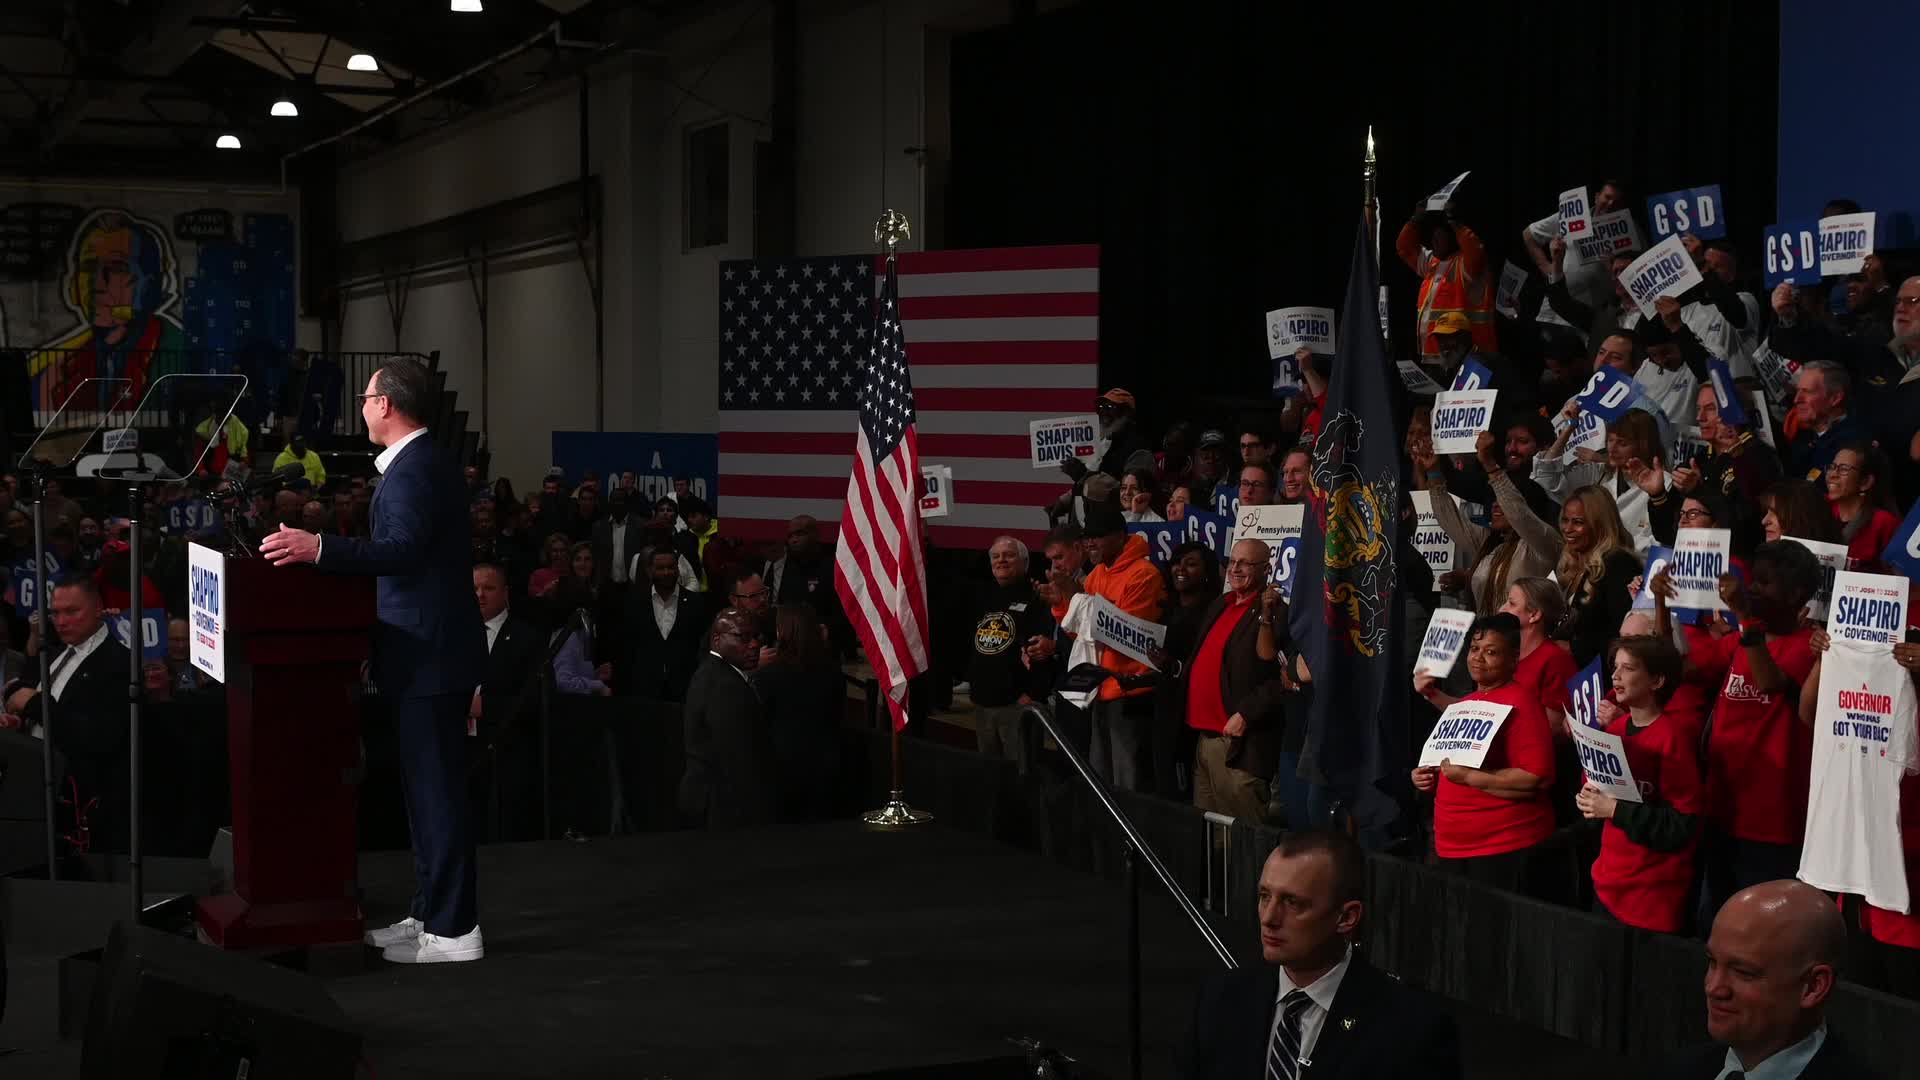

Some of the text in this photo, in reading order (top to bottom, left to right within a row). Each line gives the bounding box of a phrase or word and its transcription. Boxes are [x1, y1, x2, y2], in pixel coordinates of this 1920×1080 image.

[1560, 199, 1584, 219] PIRO
[1820, 230, 1866, 253] HAPIRO
[1821, 251, 1857, 262] OVERNOR
[1630, 252, 1684, 300] SHAPIRO
[1645, 274, 1680, 303] GOVERNOR
[1271, 319, 1329, 340] SAPIRO
[1281, 336, 1320, 346] GOERNOR
[1578, 371, 1631, 409] SD
[1434, 407, 1486, 430] SHAPIRO
[1036, 426, 1094, 446] SHAPIRO
[1440, 429, 1473, 439] GOVERNOR
[650, 450, 663, 469] A
[1038, 445, 1073, 462] DAVIS
[1256, 525, 1301, 535] Pennsylvania
[1423, 551, 1448, 564] PIRO
[1671, 551, 1723, 578] SHAPIRO
[191, 564, 219, 616] SHAPIRO
[1677, 579, 1714, 592] GOVERNOR
[196, 610, 215, 635] GOVERNOR
[1836, 596, 1901, 631] SHAPIRO
[1096, 610, 1154, 650] SHAPIRO
[1845, 627, 1889, 643] GOVERNOR
[1105, 631, 1146, 656] GOVERNOR
[1862, 683, 1868, 691] A
[1839, 691, 1892, 715] GOVERNOR
[1846, 712, 1880, 723] WHO HAS
[1433, 718, 1494, 741] SHAPIRO
[1833, 721, 1850, 736] GOT
[1852, 722, 1873, 740] YOUR
[1435, 740, 1472, 750] GOVERNOR
[1577, 740, 1623, 777] APIRO
[1585, 769, 1614, 785] RNOR
